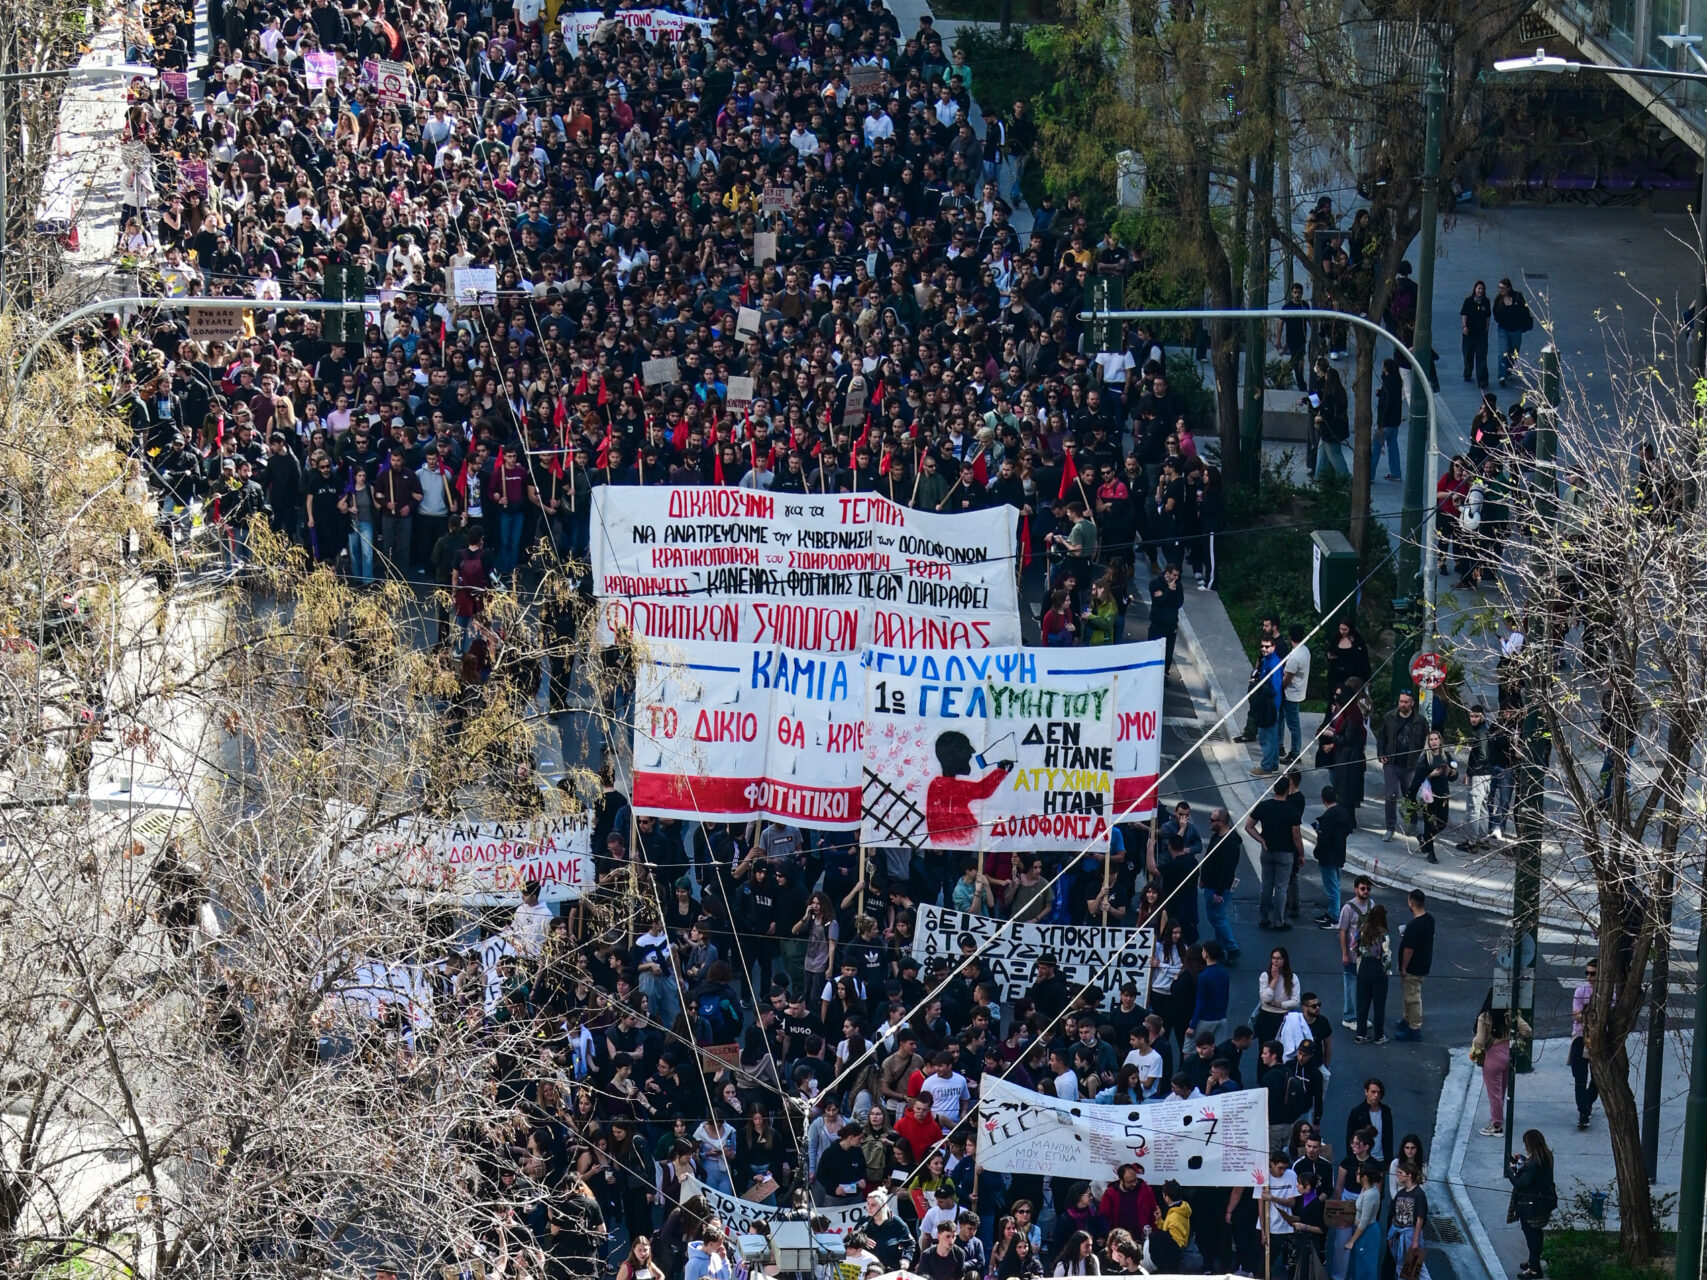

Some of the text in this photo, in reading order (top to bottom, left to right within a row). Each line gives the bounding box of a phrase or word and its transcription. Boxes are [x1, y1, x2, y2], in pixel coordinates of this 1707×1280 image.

[668, 489, 905, 528] ΔΙΚΑΙΟΣΥΝΗ για τα ΤΕΜΠΗ
[632, 522, 988, 564] ΝΑ ΑΝΑΤΡΕΨΟΥΜΕ την ΚΥΒΕΡΝΗΣΗ των ΔΟΛΟΦΟΝΩΝ
[652, 546, 952, 582] ΚΡΑΤΙΚΟΠΟΙΗΣΗ του ΣΙΔΗΡΟΔΡΟΜΟΥ ΤΩΡΑ
[786, 568, 853, 598] ΦΟΙΤΗΤΗΣ
[906, 579, 989, 610] ΔΙΑΓΡΑΦΕΙ
[751, 650, 849, 702] ΚΑΜΙΑ
[918, 684, 988, 719] ΓΕΛ
[987, 685, 1109, 721] ΥΜΗΤΤΟΥ
[646, 704, 679, 739] ΤΟ
[694, 708, 758, 743] ΔΙΚΙΟ
[777, 715, 806, 750] ΘΑ
[1020, 721, 1082, 746] ΔΕΝ
[1043, 745, 1114, 772] ΗΤΑΝΕ
[1013, 768, 1112, 793] ΑΤΥΧΗΜΑ
[743, 781, 850, 819] ΦΟΙΤΗΤΙΚΟΙ
[1043, 790, 1105, 816] ΗΤΑΝ
[989, 813, 1110, 843] ΔΟΛΟΦΟΝΙΑ
[938, 911, 1152, 950] ΕΙΣΤΕ ΥΠΟΚΡΙΤΕΣ
[789, 1025, 812, 1036] HUGO
[1031, 1140, 1081, 1154] ΜΑΝΟΥΛΑ
[1124, 1124, 1147, 1150] 5
[1195, 1118, 1219, 1147] 7
[1015, 1148, 1039, 1159] ΜΟΥ
